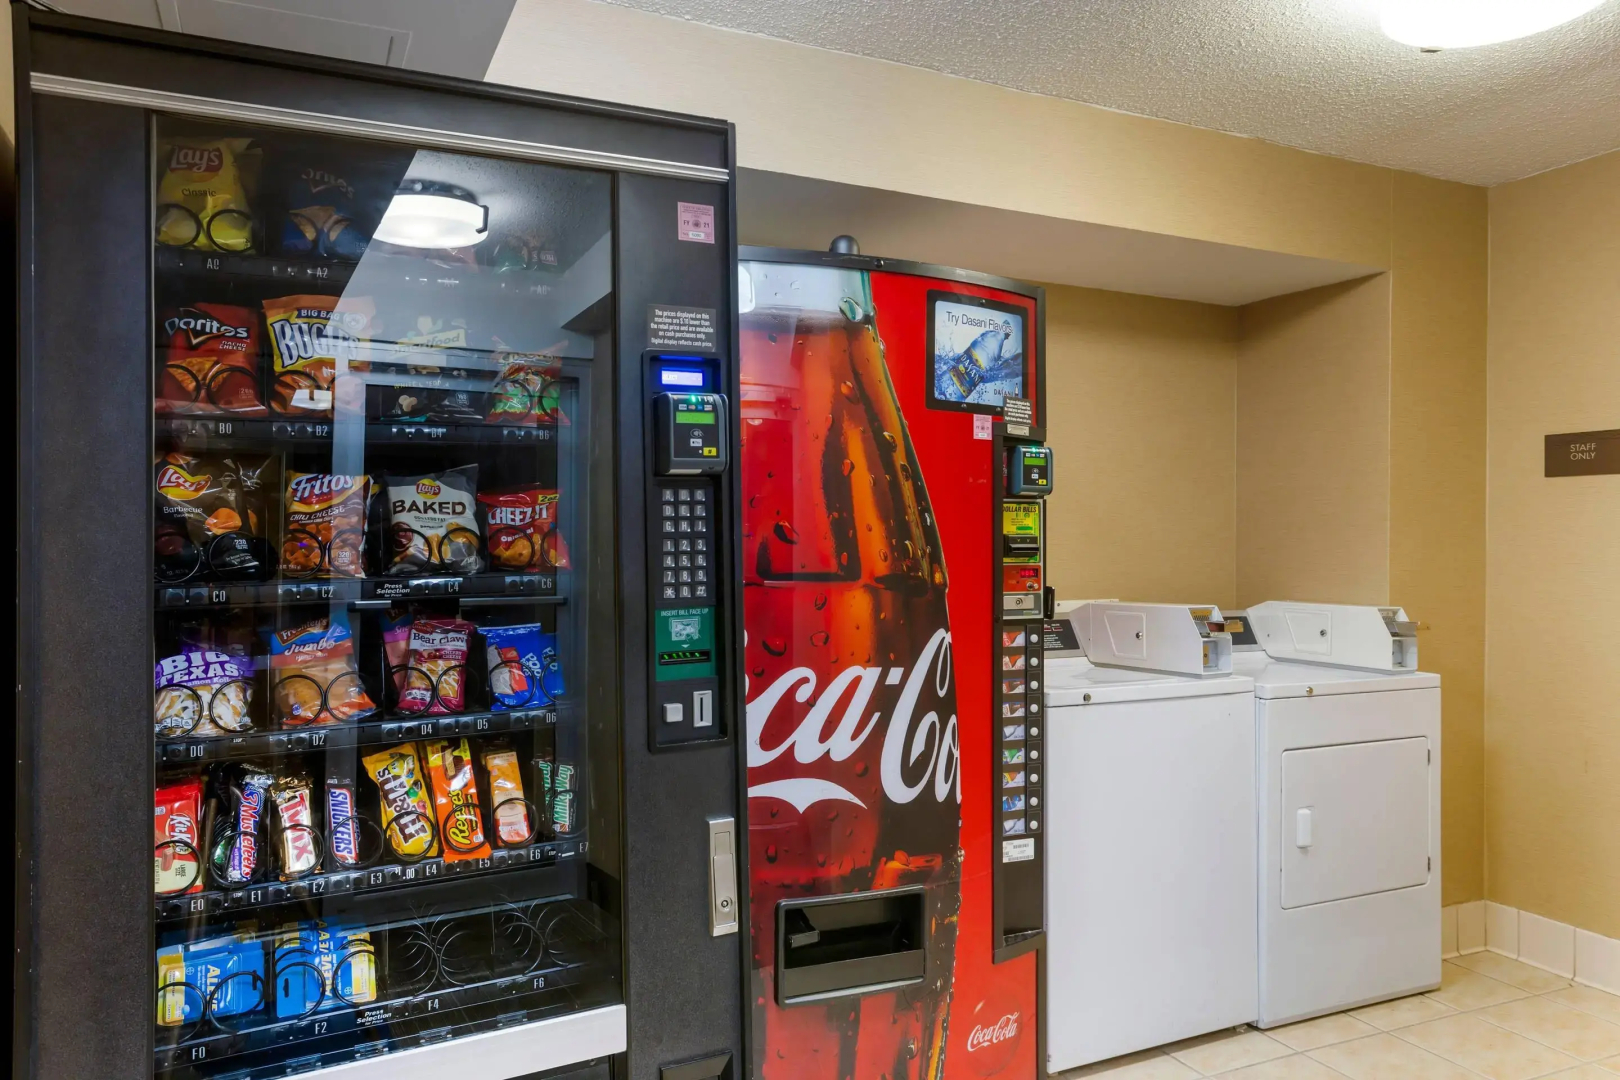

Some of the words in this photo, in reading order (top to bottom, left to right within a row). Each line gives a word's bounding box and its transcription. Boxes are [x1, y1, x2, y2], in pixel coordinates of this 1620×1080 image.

[170, 145, 220, 172] Lay's
[181, 187, 217, 197] Classic
[301, 309, 317, 317] BIG
[320, 310, 340, 320] BAG
[663, 310, 676, 318] prices
[677, 311, 695, 319] displayed
[945, 310, 959, 326] Try
[961, 313, 987, 329] Dasani
[164, 317, 248, 338] Doritos
[222, 340, 247, 348] NACHO
[315, 425, 328, 437] B2
[1570, 442, 1597, 452] STAFF
[1570, 452, 1596, 460] ONLY
[291, 473, 355, 501] Fritos
[418, 484, 439, 495] Lay's
[665, 491, 671, 499] A
[163, 506, 203, 514] Barbecue
[290, 513, 309, 521] CHILI
[311, 505, 345, 519] CHEESE
[392, 499, 467, 516] BAKED
[697, 505, 702, 513] F
[666, 522, 671, 531] G
[682, 521, 687, 530] H
[667, 540, 671, 549] 1
[682, 540, 687, 549] 2
[698, 540, 702, 549] 3
[666, 556, 671, 565] 4
[682, 556, 687, 565] 5
[698, 555, 703, 564] 6
[666, 571, 672, 580] 7
[683, 571, 688, 579] 8
[698, 570, 703, 579] 9
[448, 582, 459, 592] C4
[541, 578, 552, 589] C6
[321, 586, 334, 598] C2
[376, 587, 411, 595] Selection
[683, 586, 688, 595] 0
[413, 632, 436, 644] Bear
[440, 633, 465, 644] Claw
[284, 637, 335, 655] Jumbo
[160, 651, 230, 676] BIG
[296, 654, 315, 662] Honey
[160, 663, 240, 687] TEXAS
[555, 764, 574, 791] Way
[243, 789, 260, 806] 3
[552, 791, 573, 824] Milky
[280, 791, 315, 863] TWIX
[330, 788, 353, 854] SNICKERS
[239, 803, 260, 880] Musketeers
[579, 842, 589, 853] E7
[530, 848, 541, 860] E6
[479, 857, 490, 868] E5
[426, 864, 437, 876] E4
[370, 872, 382, 884] E3
[312, 881, 325, 893] E2
[251, 891, 262, 903] E1
[533, 977, 545, 988] F6
[428, 998, 439, 1011] F4
[356, 1012, 392, 1024] Selection
[364, 1009, 384, 1018] Press
[315, 1022, 327, 1035] F2
[967, 1011, 1020, 1052] Coca-Cola
